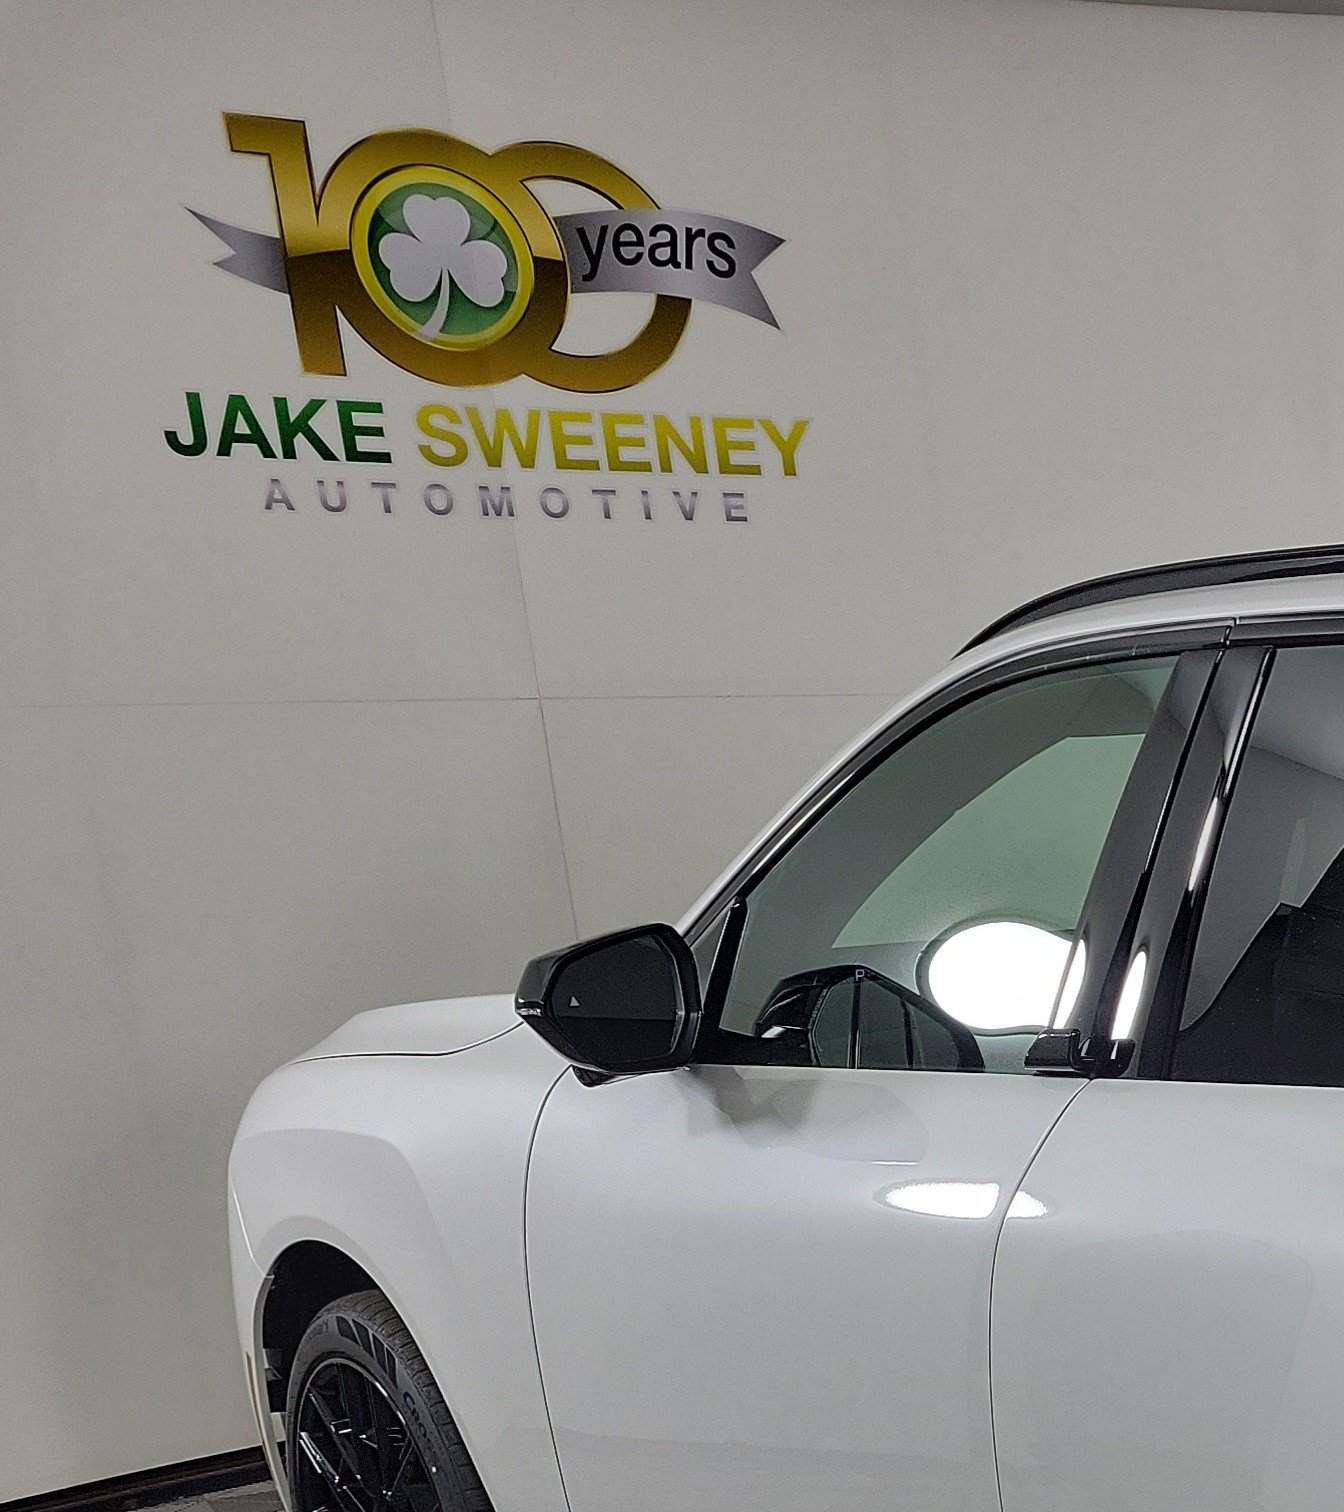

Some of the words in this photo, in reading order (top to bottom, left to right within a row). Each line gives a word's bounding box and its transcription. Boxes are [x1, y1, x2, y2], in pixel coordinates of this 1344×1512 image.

[222, 111, 692, 393] 100
[575, 221, 737, 283] years
[163, 391, 393, 464] JAKE
[416, 403, 811, 477] SWEENEY
[263, 478, 749, 523] AUTOMOTIVE
